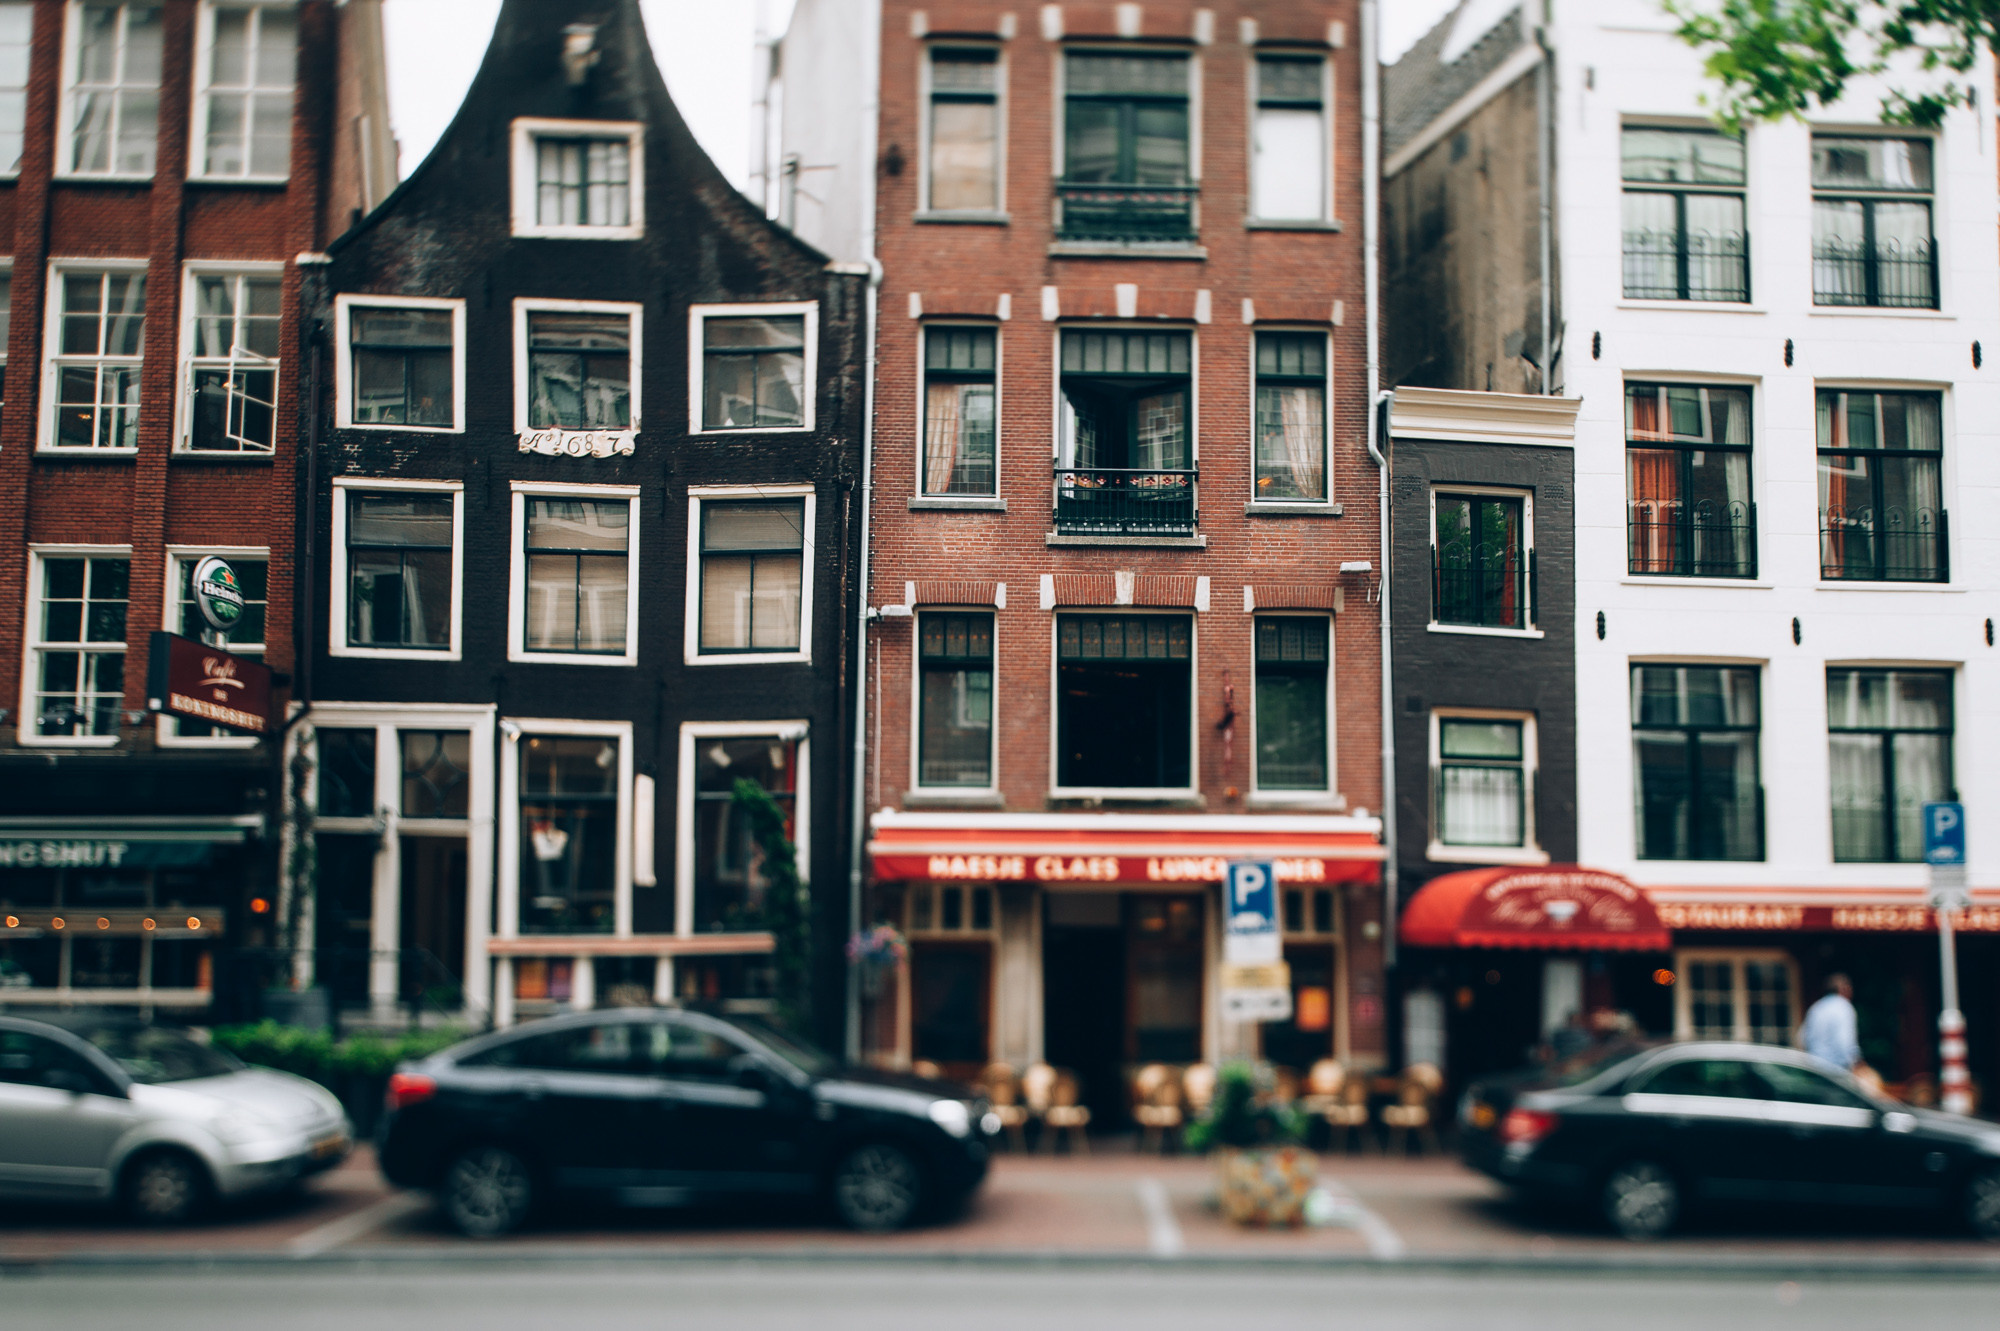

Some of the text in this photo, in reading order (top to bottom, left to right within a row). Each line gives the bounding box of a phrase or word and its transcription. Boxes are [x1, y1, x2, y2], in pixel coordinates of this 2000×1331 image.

[170, 692, 267, 732] KONINGSHUT
[1933, 806, 1958, 838] P
[1034, 856, 1120, 881] CLAES
[1234, 864, 1267, 906] P
